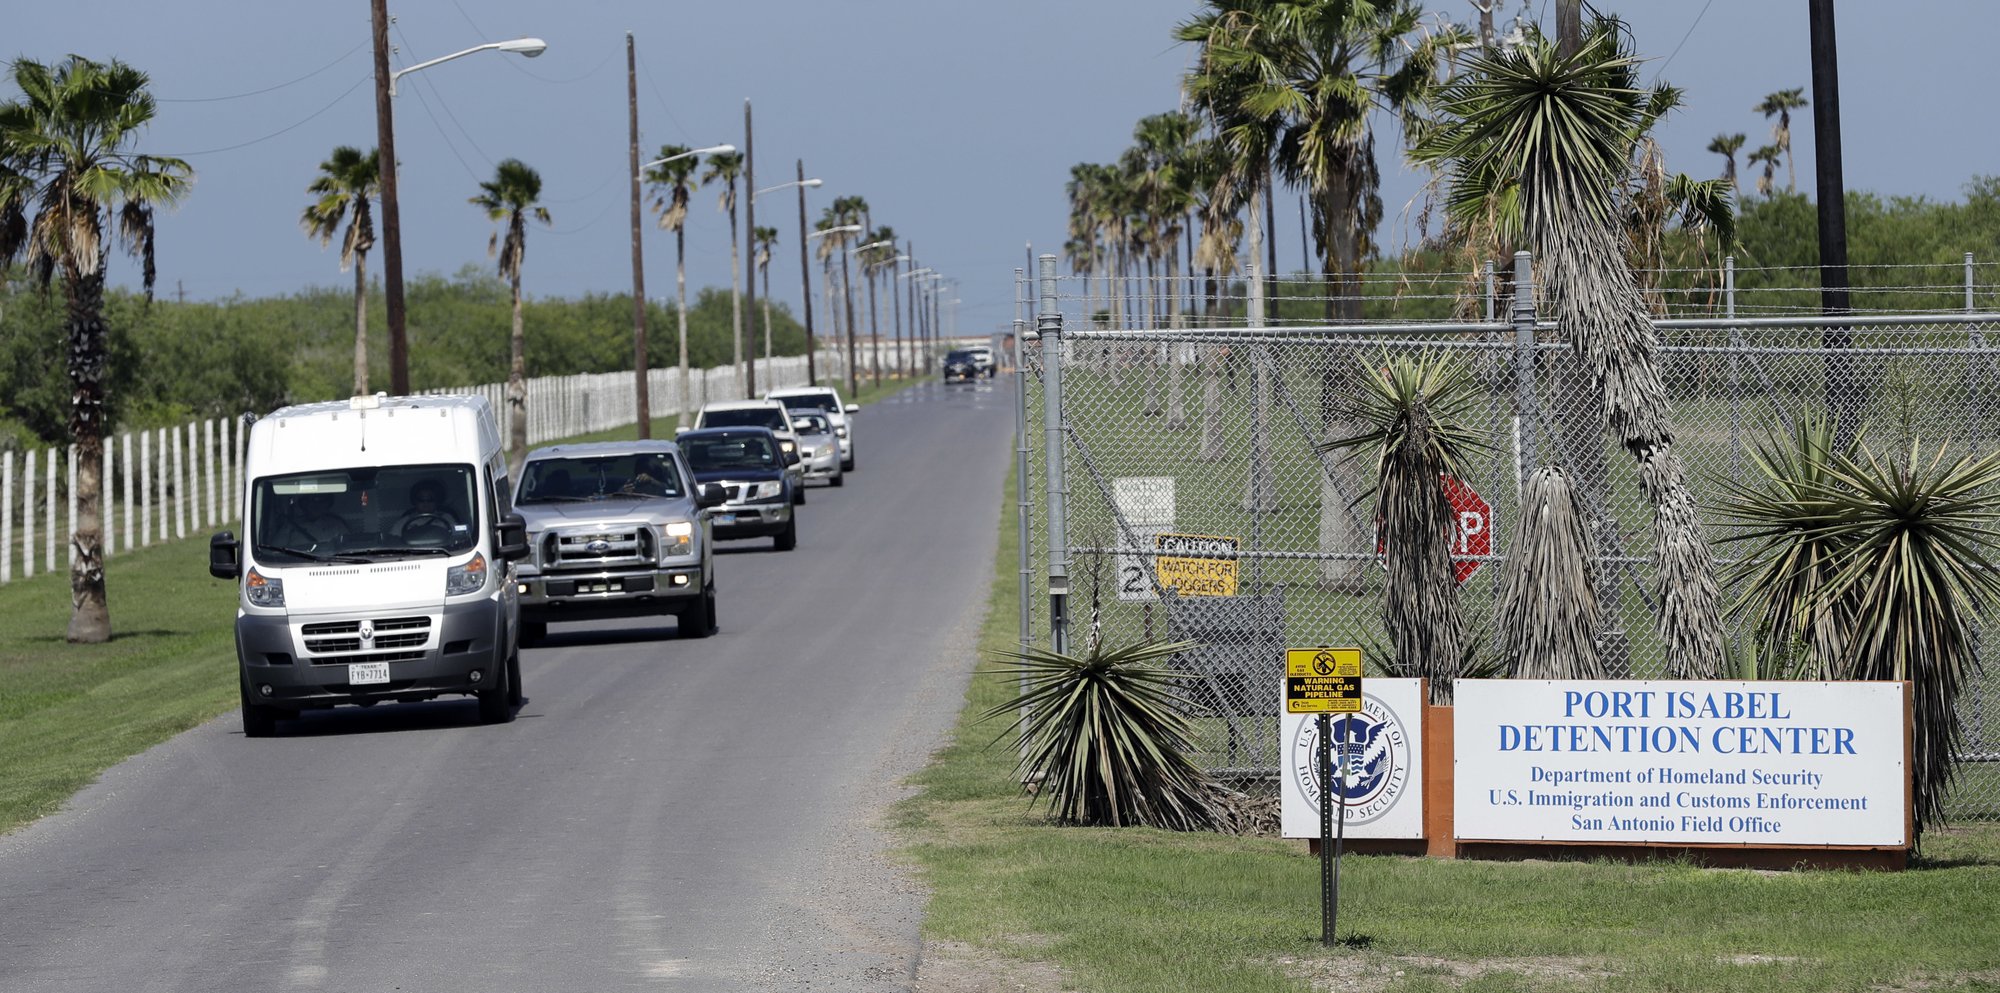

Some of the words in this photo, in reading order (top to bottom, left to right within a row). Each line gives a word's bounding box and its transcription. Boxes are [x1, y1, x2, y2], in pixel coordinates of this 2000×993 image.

[1162, 561, 1205, 575] WATCH
[1208, 562, 1232, 577] FOR
[1293, 684, 1334, 692] NATURAL
[1563, 691, 1656, 718] PORT
[1665, 691, 1791, 720] ISABEL
[1498, 725, 1702, 754] DETENTION
[1712, 726, 1858, 755] CENTER
[1530, 766, 1632, 787] Department
[1637, 767, 1655, 784] of
[1659, 768, 1747, 785] Homeland
[1752, 768, 1824, 790] Security
[1359, 765, 1405, 819] SECURITY
[1489, 789, 1523, 806] U.S.
[1528, 790, 1634, 811] Immigration
[1639, 792, 1671, 808] and
[1676, 791, 1751, 809] Customs
[1756, 792, 1868, 811] Enforcement
[1571, 814, 1603, 831] San
[1607, 815, 1675, 832] Antonio
[1681, 816, 1723, 833] Field
[1728, 816, 1782, 833] Office
